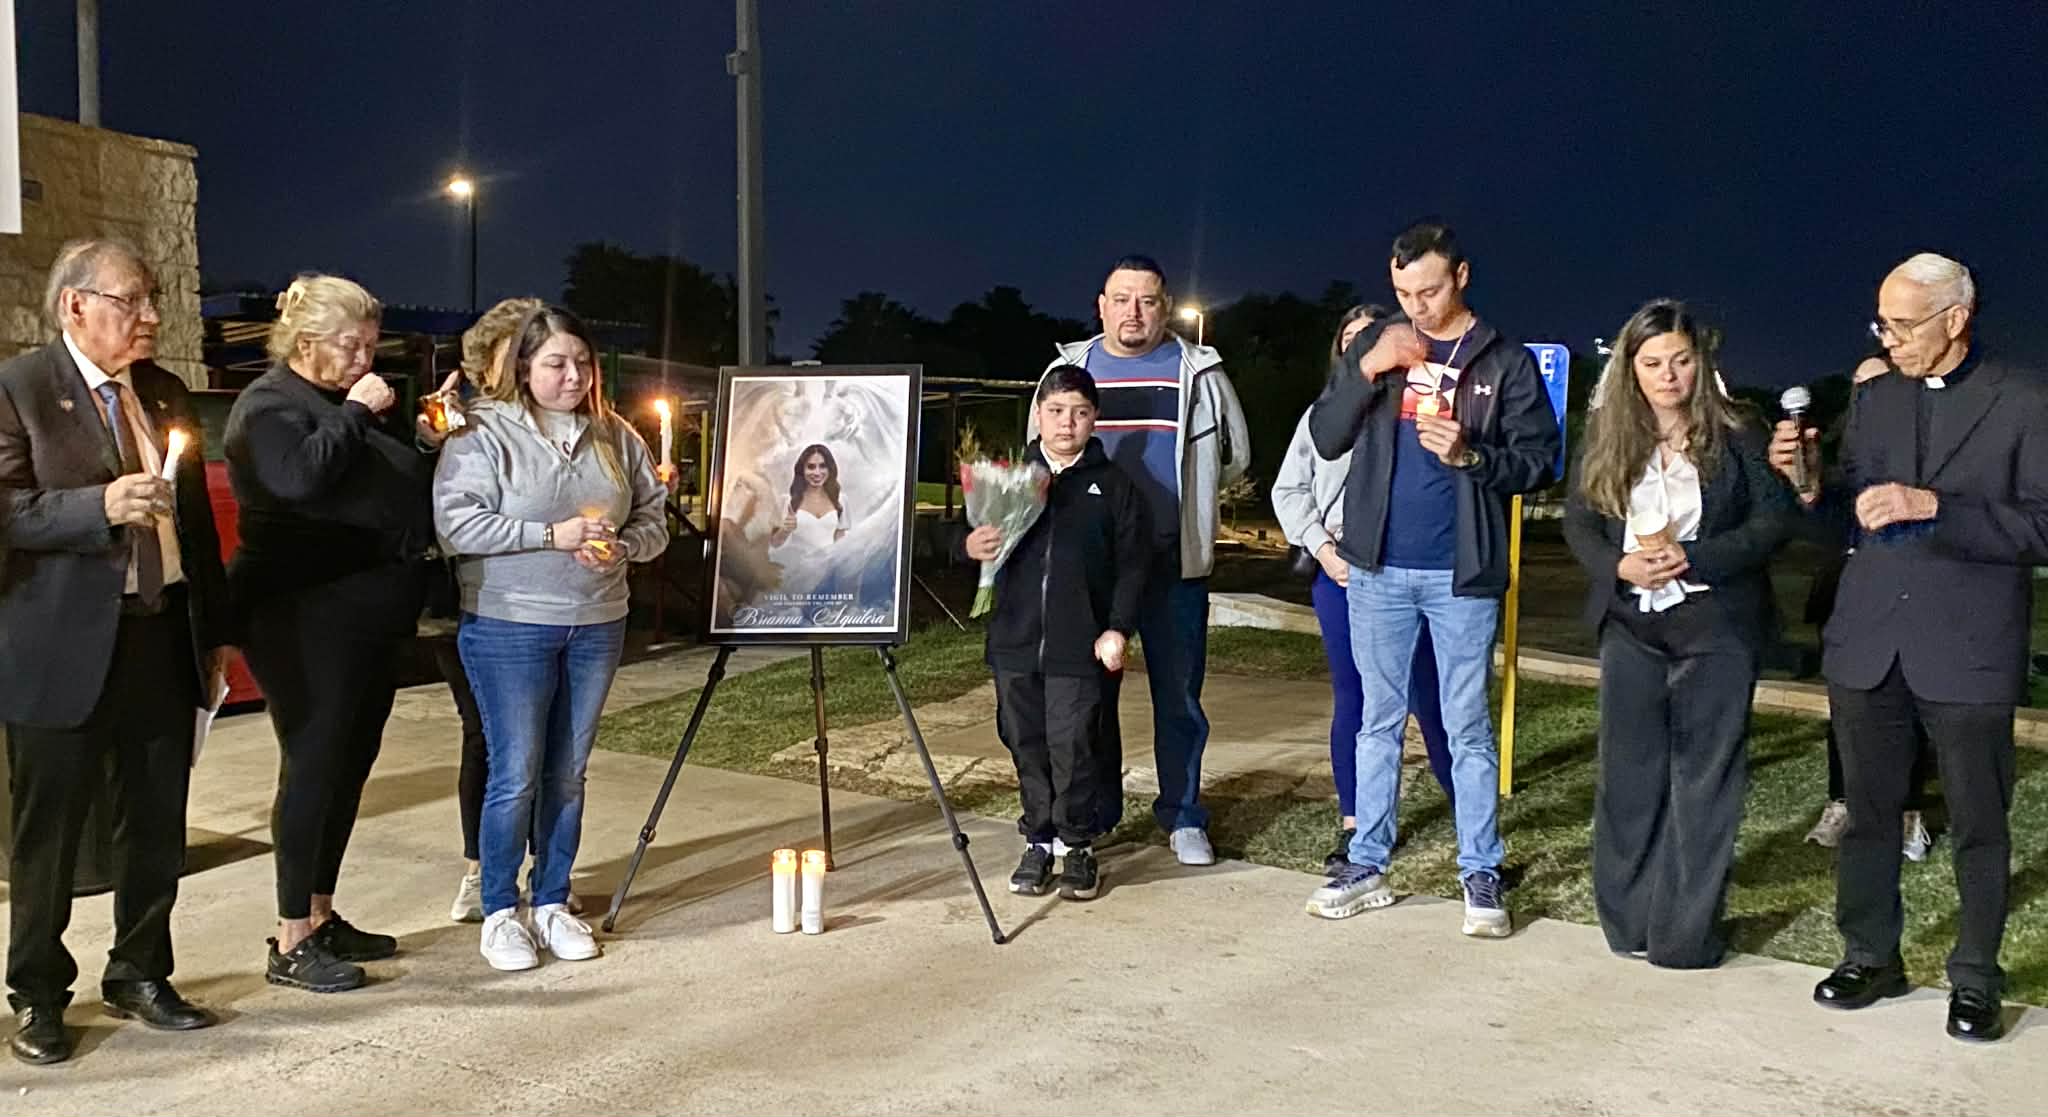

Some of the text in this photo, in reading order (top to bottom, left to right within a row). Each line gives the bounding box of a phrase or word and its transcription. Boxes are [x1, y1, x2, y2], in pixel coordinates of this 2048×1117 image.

[764, 593, 854, 601] VIGIL TO REMEMBER
[733, 607, 803, 626] Brianna
